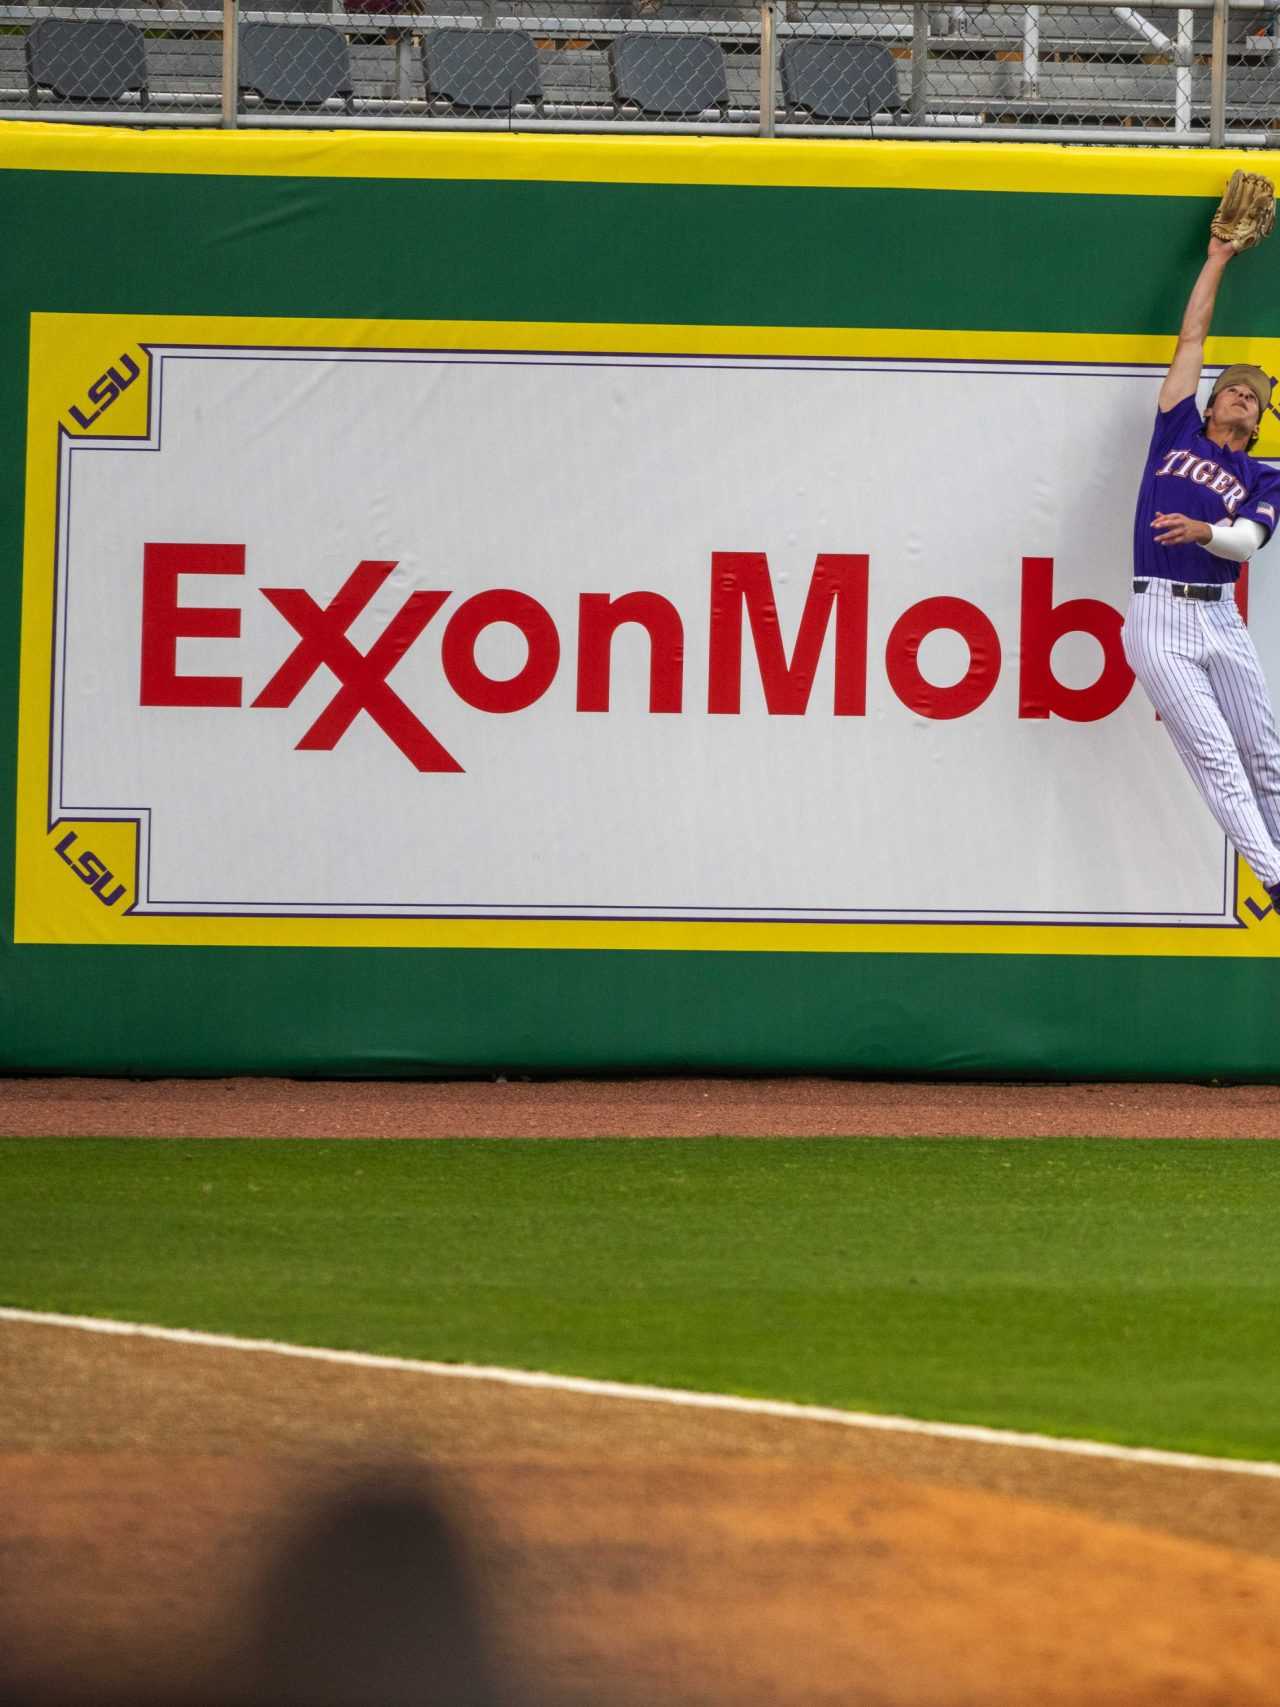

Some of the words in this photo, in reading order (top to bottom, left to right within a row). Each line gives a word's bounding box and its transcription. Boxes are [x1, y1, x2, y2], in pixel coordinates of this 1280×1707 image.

[68, 353, 140, 430] LSU
[1155, 449, 1249, 527] TIGER
[54, 831, 127, 906] LSU
